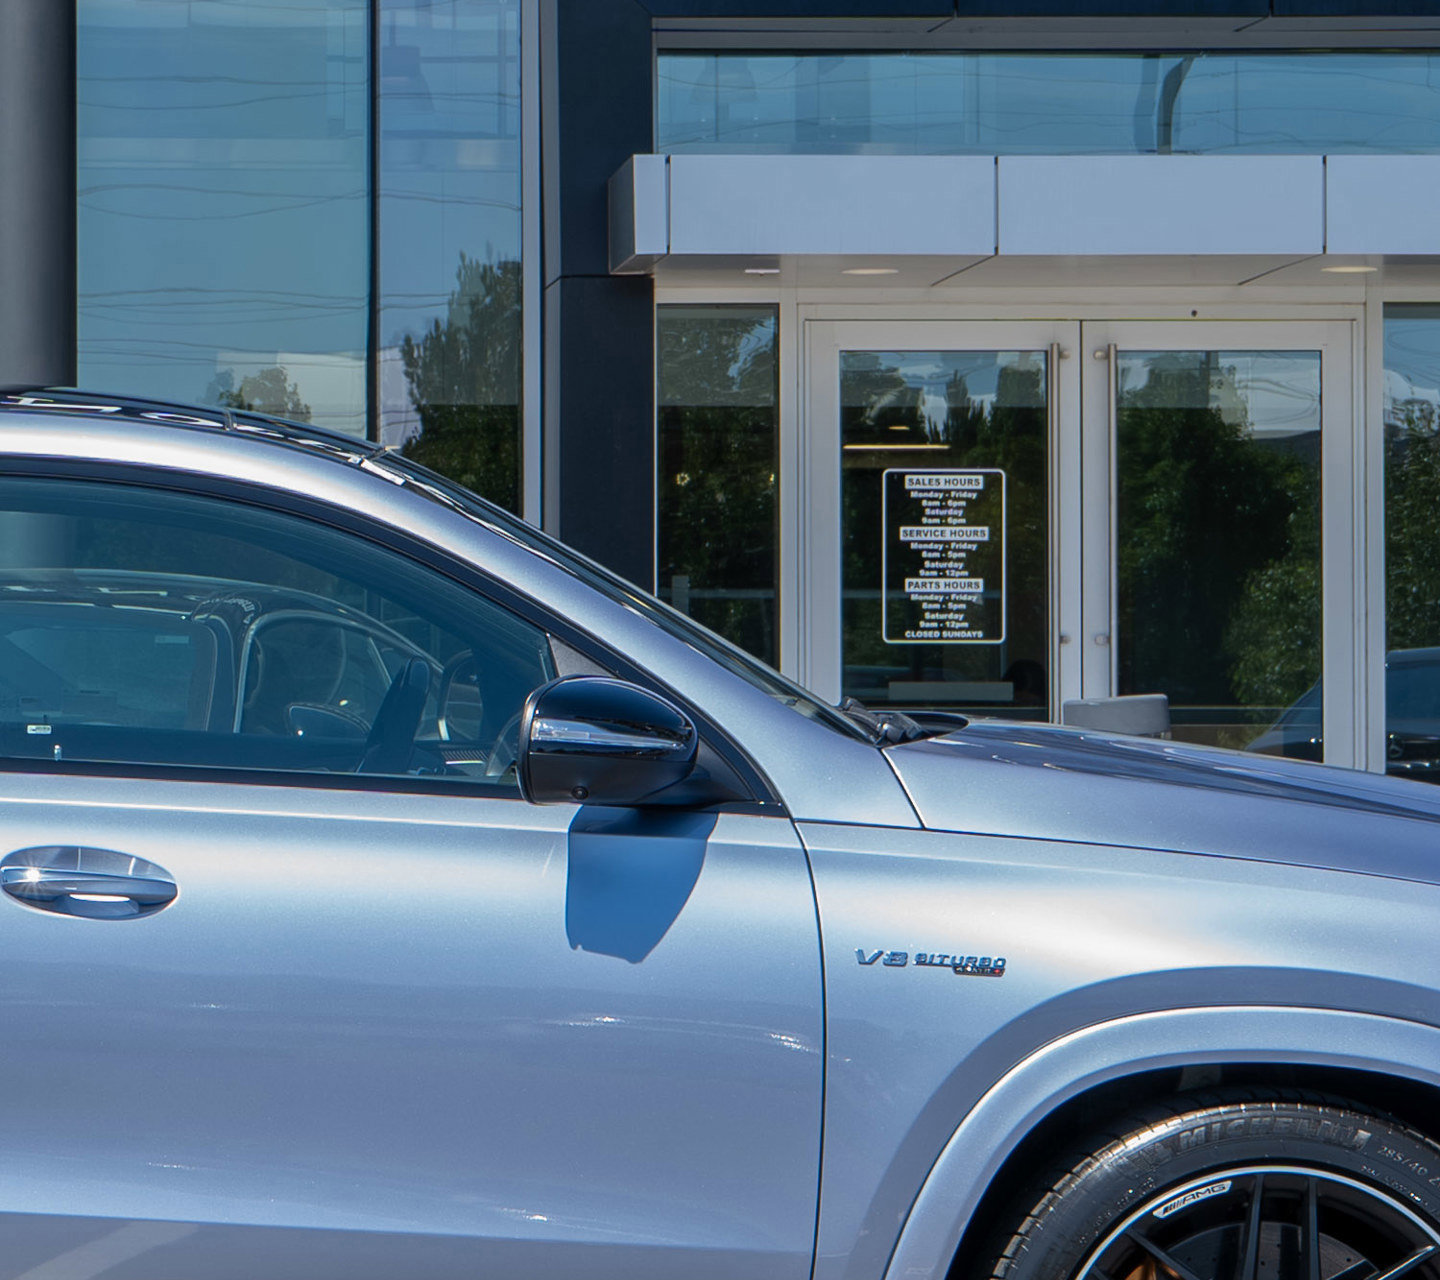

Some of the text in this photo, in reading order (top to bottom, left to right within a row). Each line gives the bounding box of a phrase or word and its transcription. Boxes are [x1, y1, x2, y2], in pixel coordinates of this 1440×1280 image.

[907, 478, 980, 486] SALES HOURS
[910, 491, 944, 499] Monday
[950, 491, 978, 499] Friday
[924, 508, 964, 516] Saturday
[902, 529, 986, 537] SERVICE HOURS
[910, 542, 944, 550] Monday
[950, 542, 978, 550] Friday
[947, 551, 967, 559] 5pm
[923, 561, 965, 569] Saturday
[919, 569, 938, 577] 9am
[945, 569, 969, 578] 12pm
[907, 581, 980, 589] PARTS HOURS
[910, 594, 944, 602] Monday
[950, 594, 978, 602] Friday
[924, 612, 965, 620] Saturday
[945, 621, 969, 629] 12pm
[904, 630, 984, 638] CLOSED SUNDAYS
[853, 947, 1007, 969] V8 BITURBO
